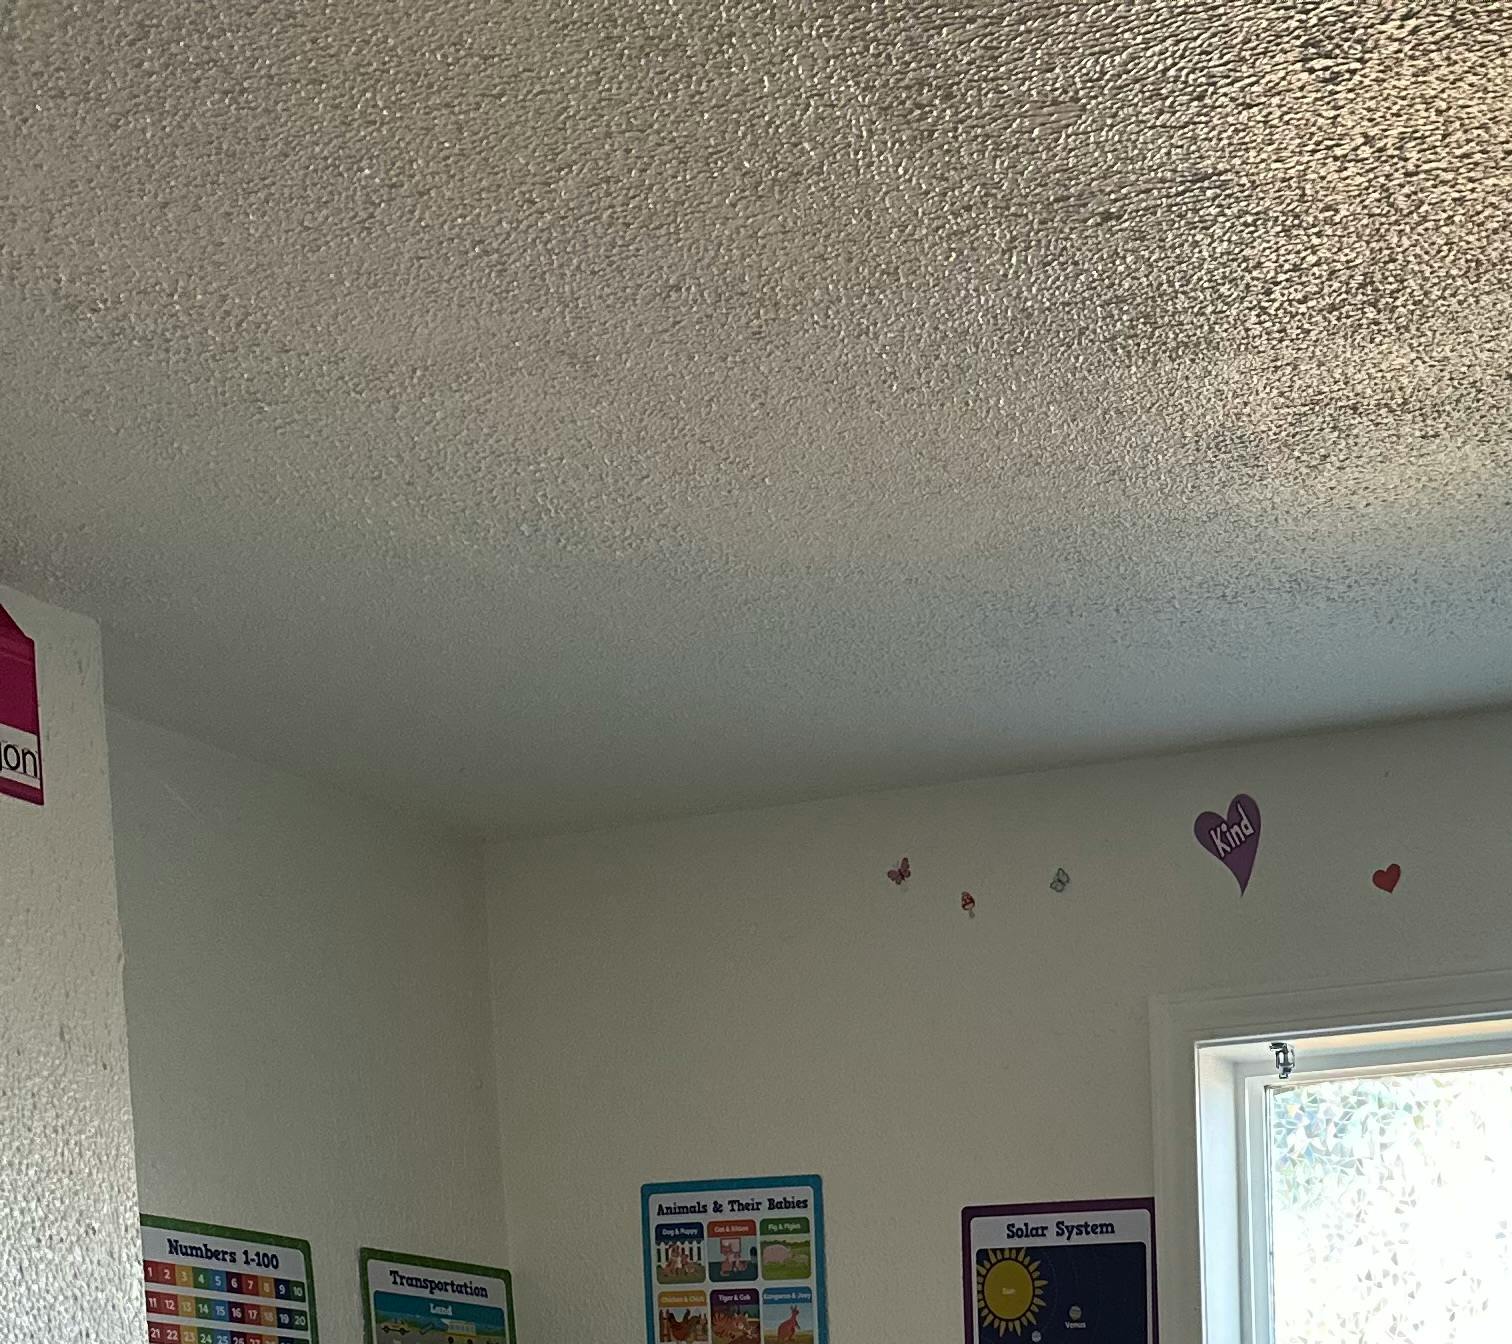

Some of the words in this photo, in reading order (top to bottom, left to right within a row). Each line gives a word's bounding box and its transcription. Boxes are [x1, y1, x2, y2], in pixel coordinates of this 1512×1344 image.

[1209, 801, 1255, 859] Kind
[656, 1201, 708, 1217] Animals
[711, 1200, 723, 1213] &
[727, 1199, 762, 1213] Their
[767, 1197, 809, 1211] Babies
[1006, 1223, 1048, 1239] Solar
[1055, 1220, 1115, 1240] System
[167, 1238, 236, 1264] Numbers
[243, 1250, 279, 1269] 1-100
[389, 1269, 489, 1299] Transportation
